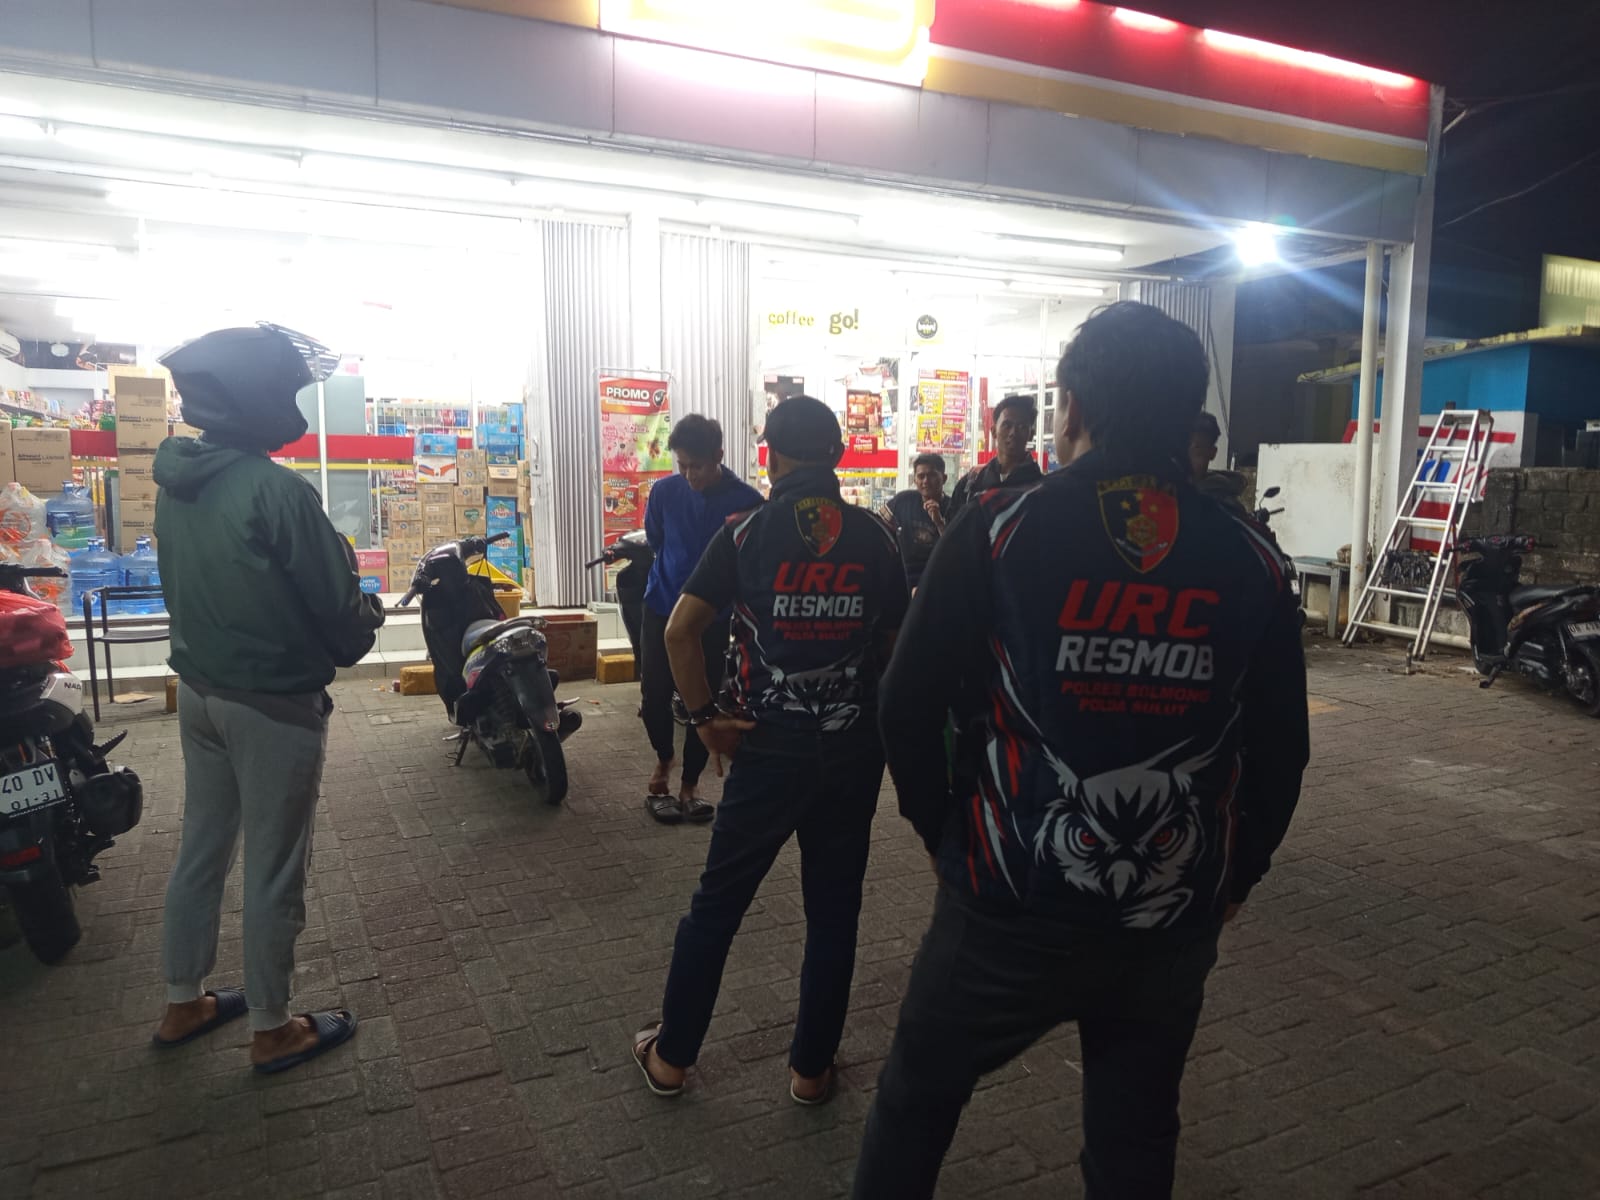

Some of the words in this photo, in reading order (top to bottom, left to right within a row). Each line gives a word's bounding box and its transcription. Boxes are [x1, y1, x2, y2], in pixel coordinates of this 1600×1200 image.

[768, 311, 815, 326] coffee
[829, 308, 859, 335] go!
[606, 386, 650, 400] PROMO
[773, 561, 864, 593] URC
[773, 594, 864, 617] RESMOB
[1058, 579, 1220, 638] URC
[1055, 635, 1214, 680] RESMOB
[32, 766, 56, 786] DV
[11, 788, 61, 811] 01-31
